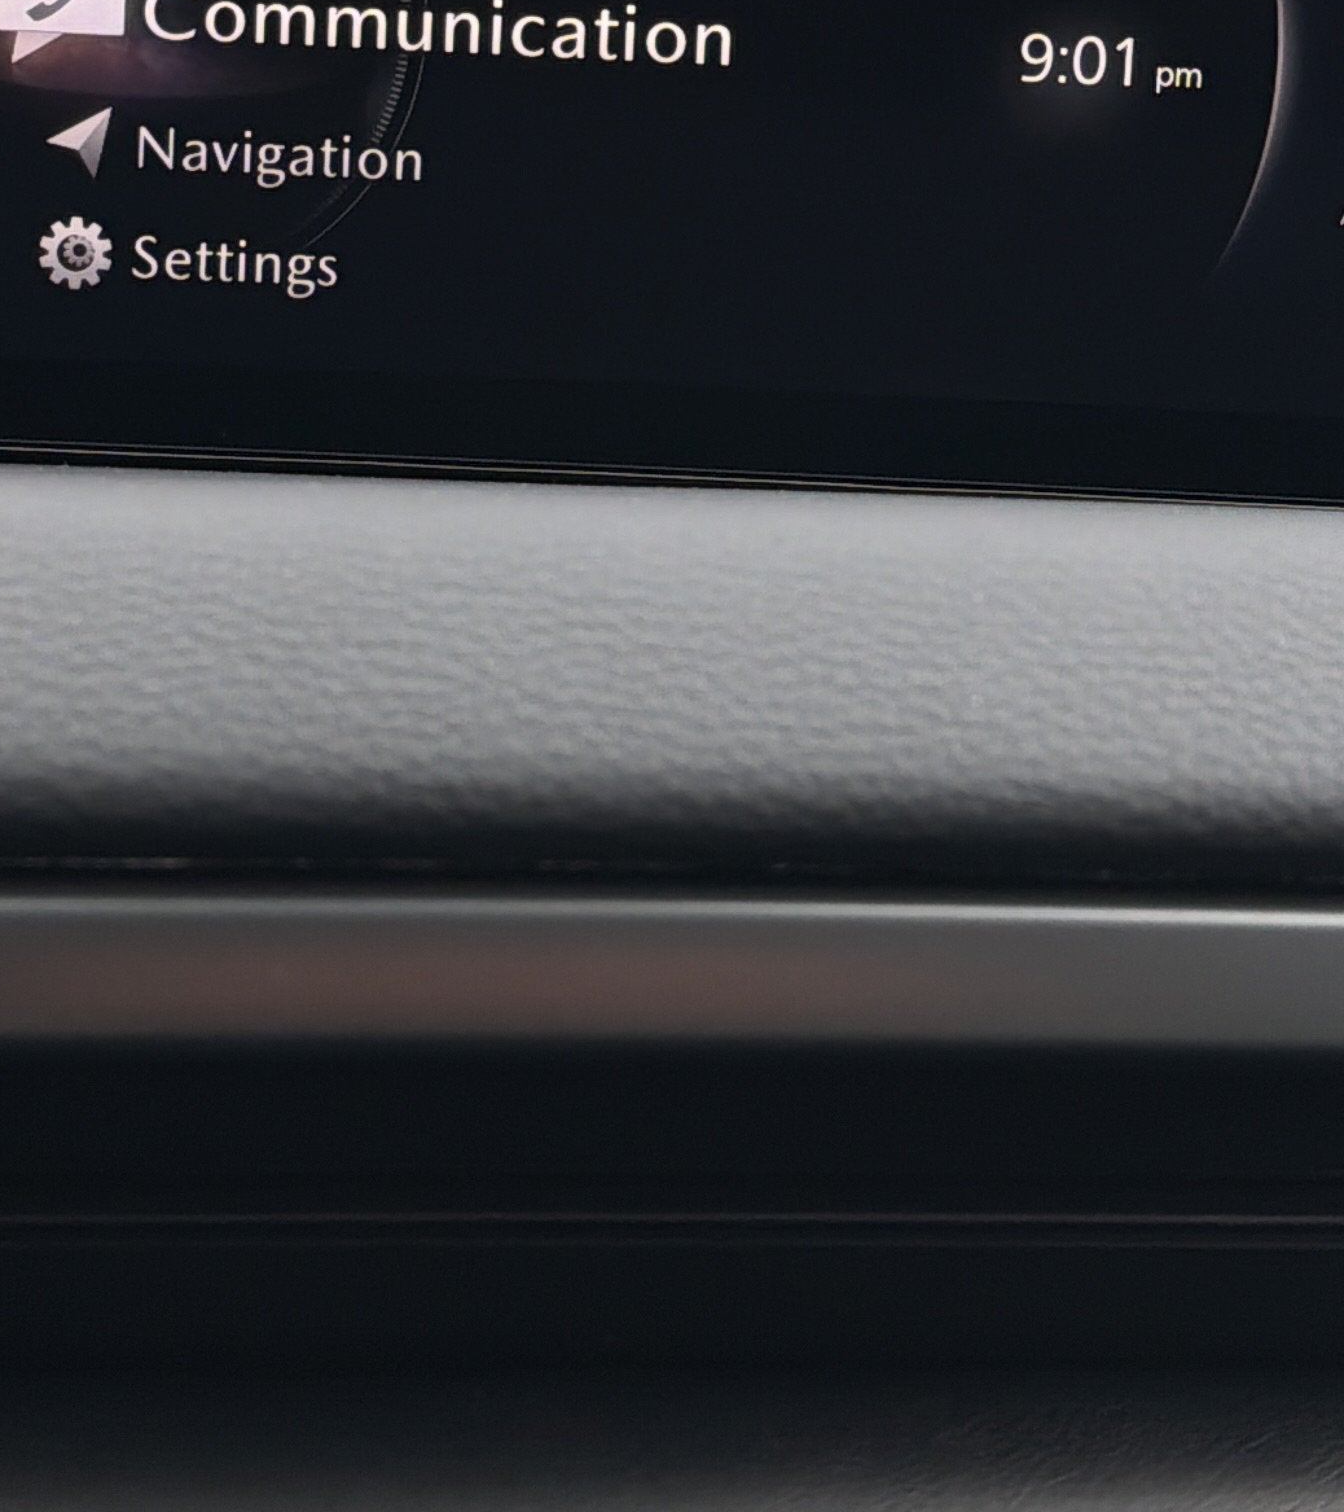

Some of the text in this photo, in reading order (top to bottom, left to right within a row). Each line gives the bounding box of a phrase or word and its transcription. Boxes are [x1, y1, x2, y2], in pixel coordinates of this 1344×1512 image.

[1019, 32, 1204, 95] 9:01 pm
[136, 125, 423, 189] Navigation
[130, 234, 339, 300] Settings
